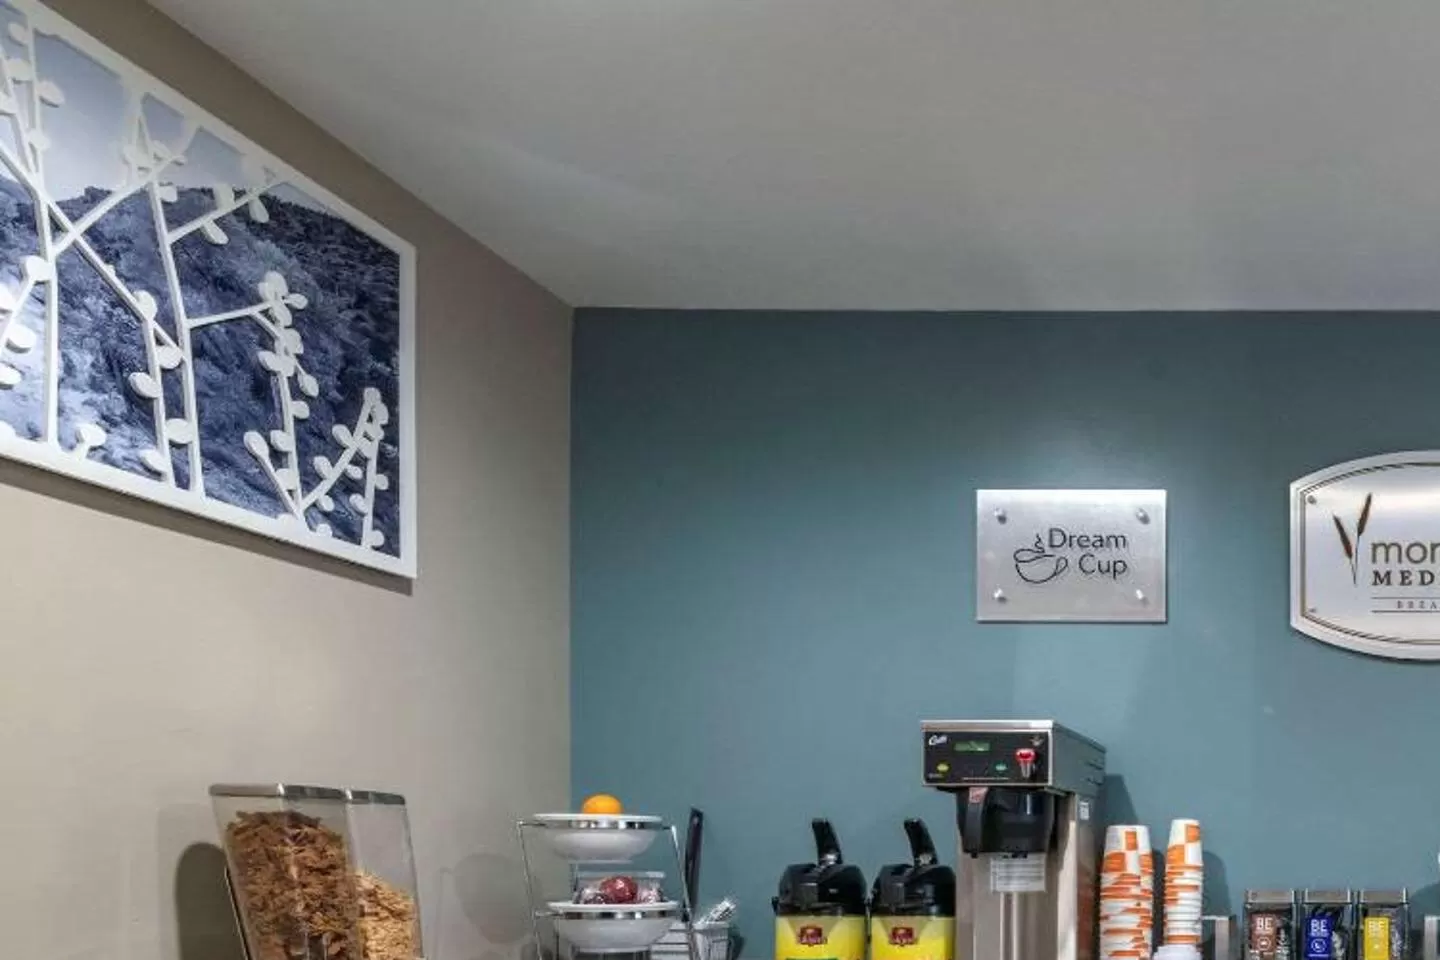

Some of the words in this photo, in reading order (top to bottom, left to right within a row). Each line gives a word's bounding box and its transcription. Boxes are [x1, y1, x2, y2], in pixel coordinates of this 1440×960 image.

[1048, 528, 1127, 548] Dream
[1078, 553, 1128, 580] Cup
[1256, 918, 1273, 931] BE
[1311, 919, 1328, 932] BE
